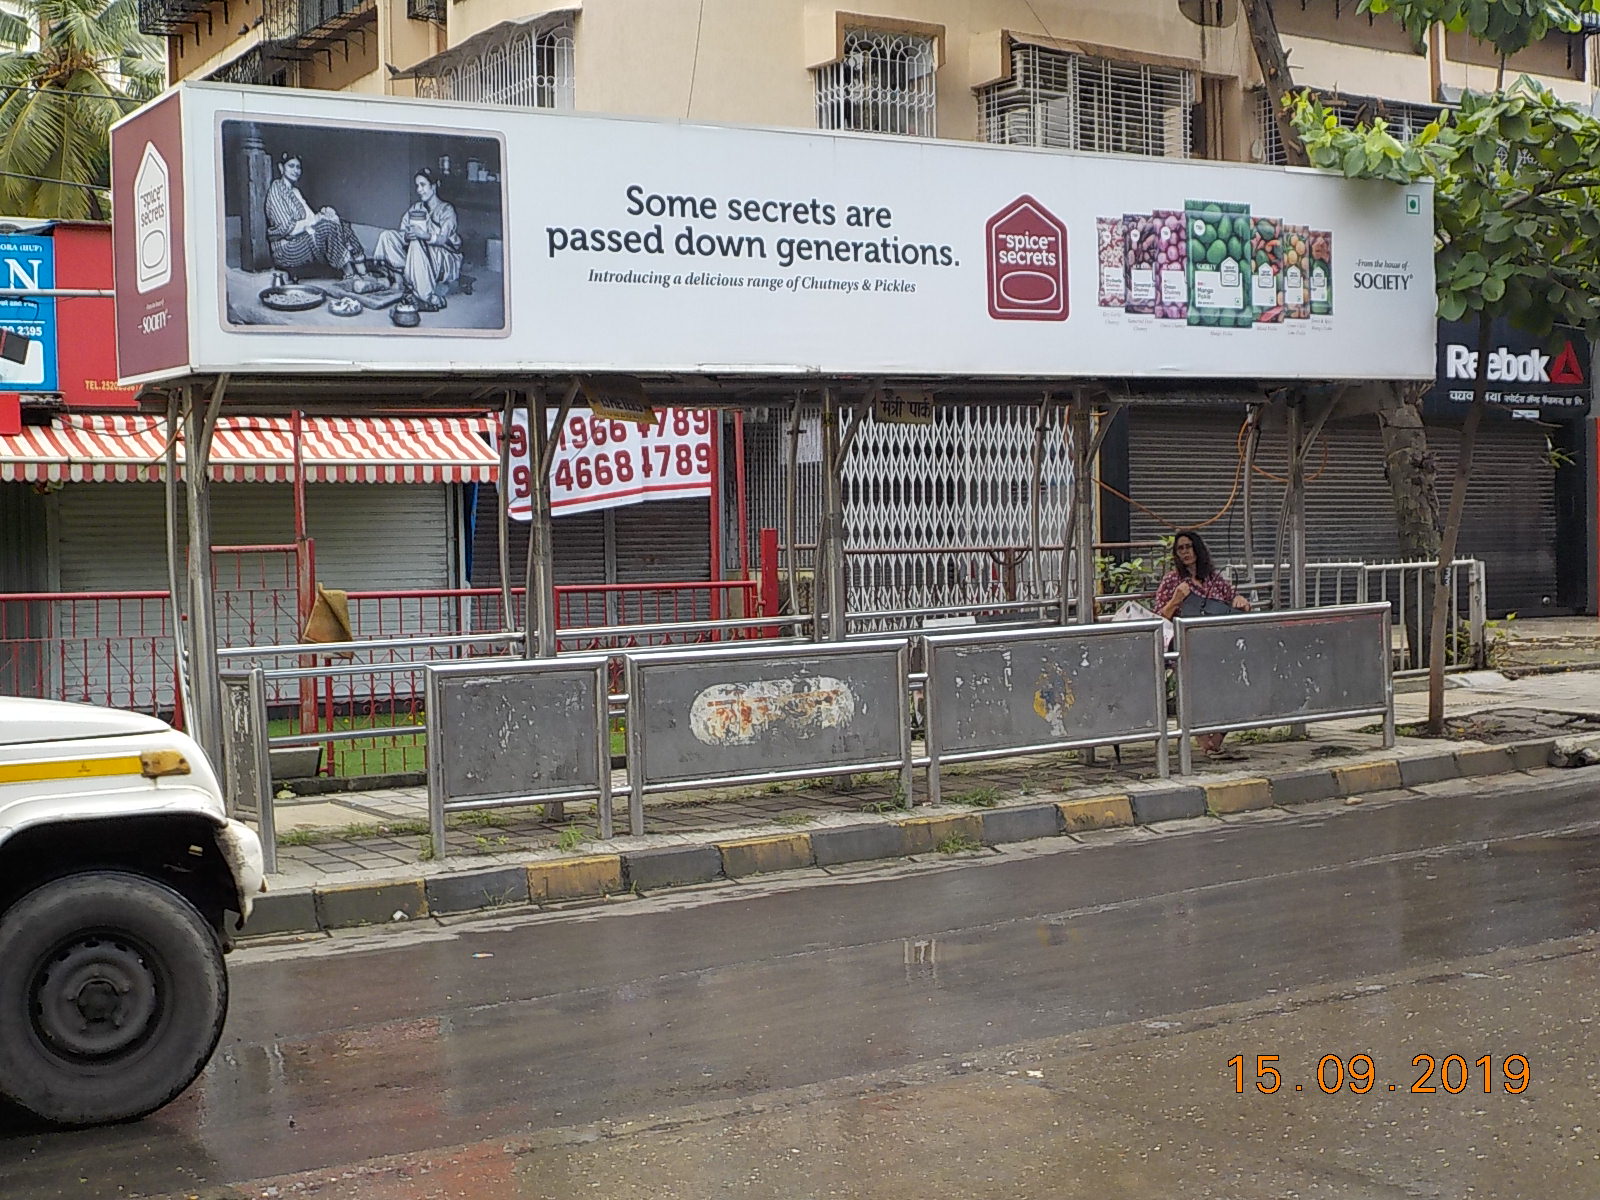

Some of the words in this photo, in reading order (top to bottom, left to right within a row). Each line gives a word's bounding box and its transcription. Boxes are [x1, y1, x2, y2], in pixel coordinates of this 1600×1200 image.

[141, 203, 165, 227] secrets
[626, 185, 717, 219] Some
[727, 199, 836, 226] secrets
[846, 205, 892, 229] are
[546, 225, 665, 258] passed
[674, 226, 767, 259] down
[776, 236, 960, 268] generations.
[999, 250, 1056, 266] secrets
[588, 269, 671, 288] Introducing
[672, 275, 682, 285] a
[684, 272, 744, 287] delicious
[747, 278, 784, 291] range
[785, 276, 799, 292] of
[801, 276, 859, 293] Chutneys
[861, 279, 872, 291] &
[874, 279, 916, 293] Pickles
[1446, 344, 1551, 383] Reebok
